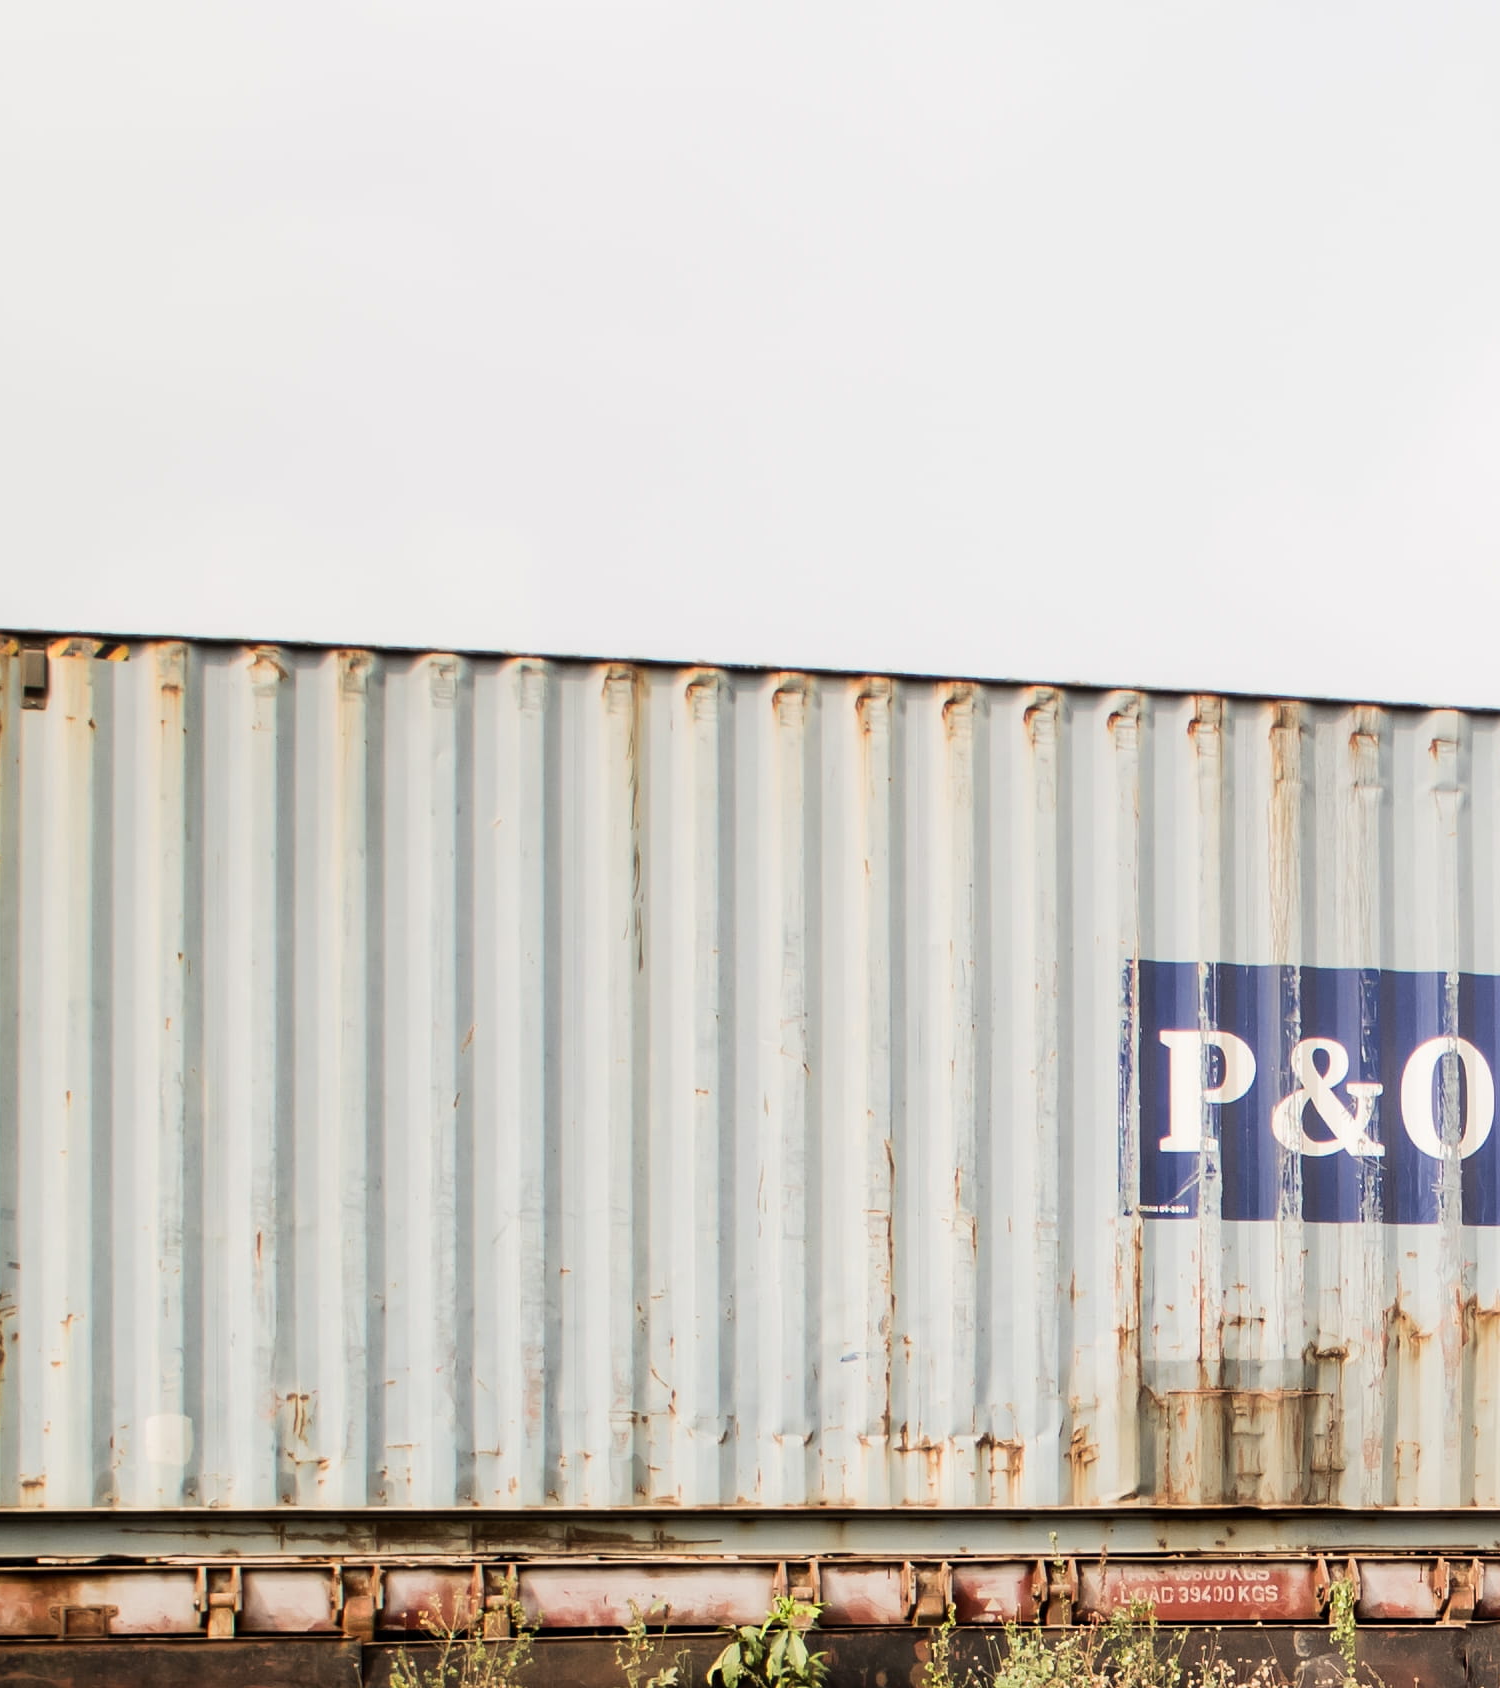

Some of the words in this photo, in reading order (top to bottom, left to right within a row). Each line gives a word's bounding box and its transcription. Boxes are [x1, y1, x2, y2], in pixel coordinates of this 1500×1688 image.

[1157, 1028, 1496, 1161] P&O
[1179, 1585, 1235, 1603] 39400
[1238, 1584, 1278, 1603] KGS
